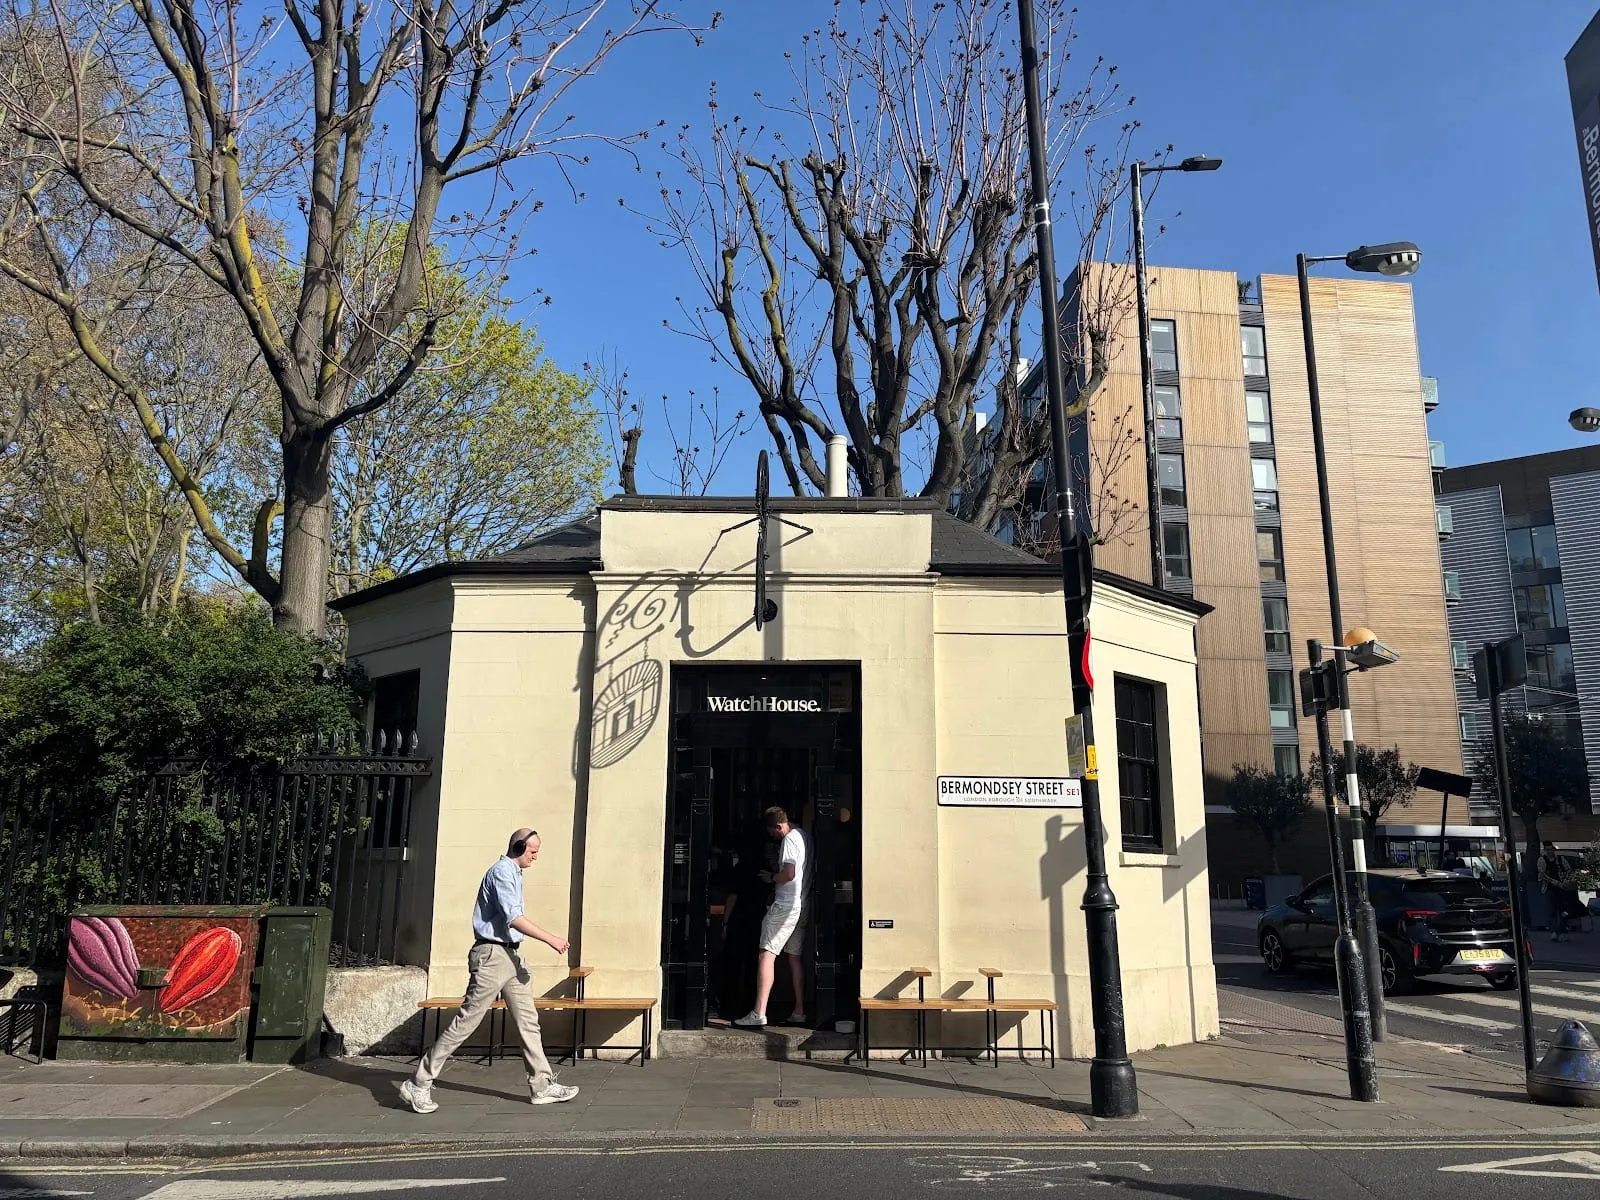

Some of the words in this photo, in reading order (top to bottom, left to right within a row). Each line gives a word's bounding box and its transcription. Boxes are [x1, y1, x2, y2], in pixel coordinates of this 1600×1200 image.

[941, 781, 1021, 795] BERMONDSEY
[1026, 782, 1064, 796] STREET
[1066, 788, 1080, 796] SE1
